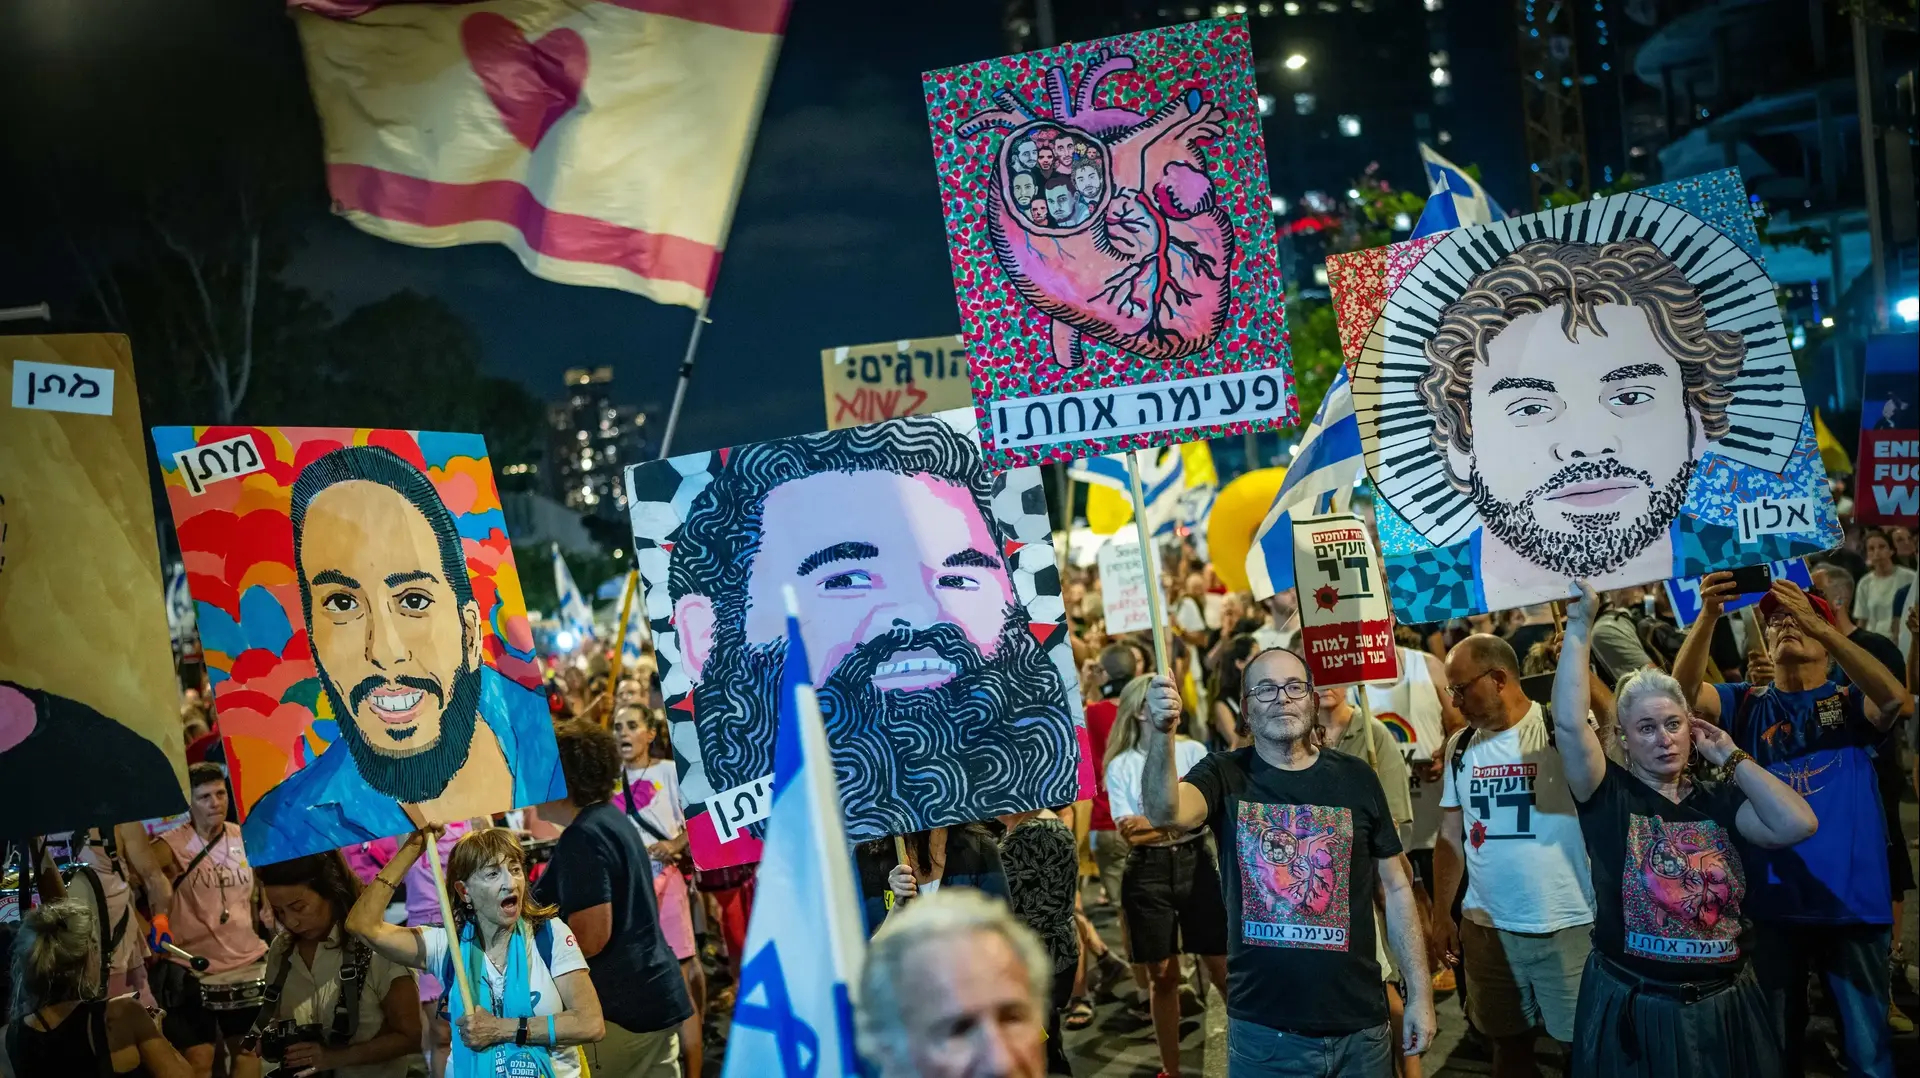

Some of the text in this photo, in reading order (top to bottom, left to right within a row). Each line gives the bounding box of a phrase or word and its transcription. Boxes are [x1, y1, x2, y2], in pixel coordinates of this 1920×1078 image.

[28, 372, 100, 405] מתן
[998, 375, 1279, 445] פעימה אחת!
[181, 440, 258, 492] מתן
[1871, 484, 1919, 516] W
[1743, 499, 1810, 540] אלון
[1313, 530, 1349, 543] לוחמים
[1313, 541, 1367, 561] זועקים
[1316, 556, 1370, 592] די
[1311, 630, 1389, 654] לא טוב למות
[1367, 650, 1387, 664] בעד
[1473, 765, 1536, 777] הורי לוחמים
[1470, 776, 1536, 798] זועקים
[714, 782, 775, 838] יתן
[1470, 793, 1536, 832] די
[1247, 923, 1344, 942] פעימה אחת!
[1632, 934, 1677, 953] אחת!
